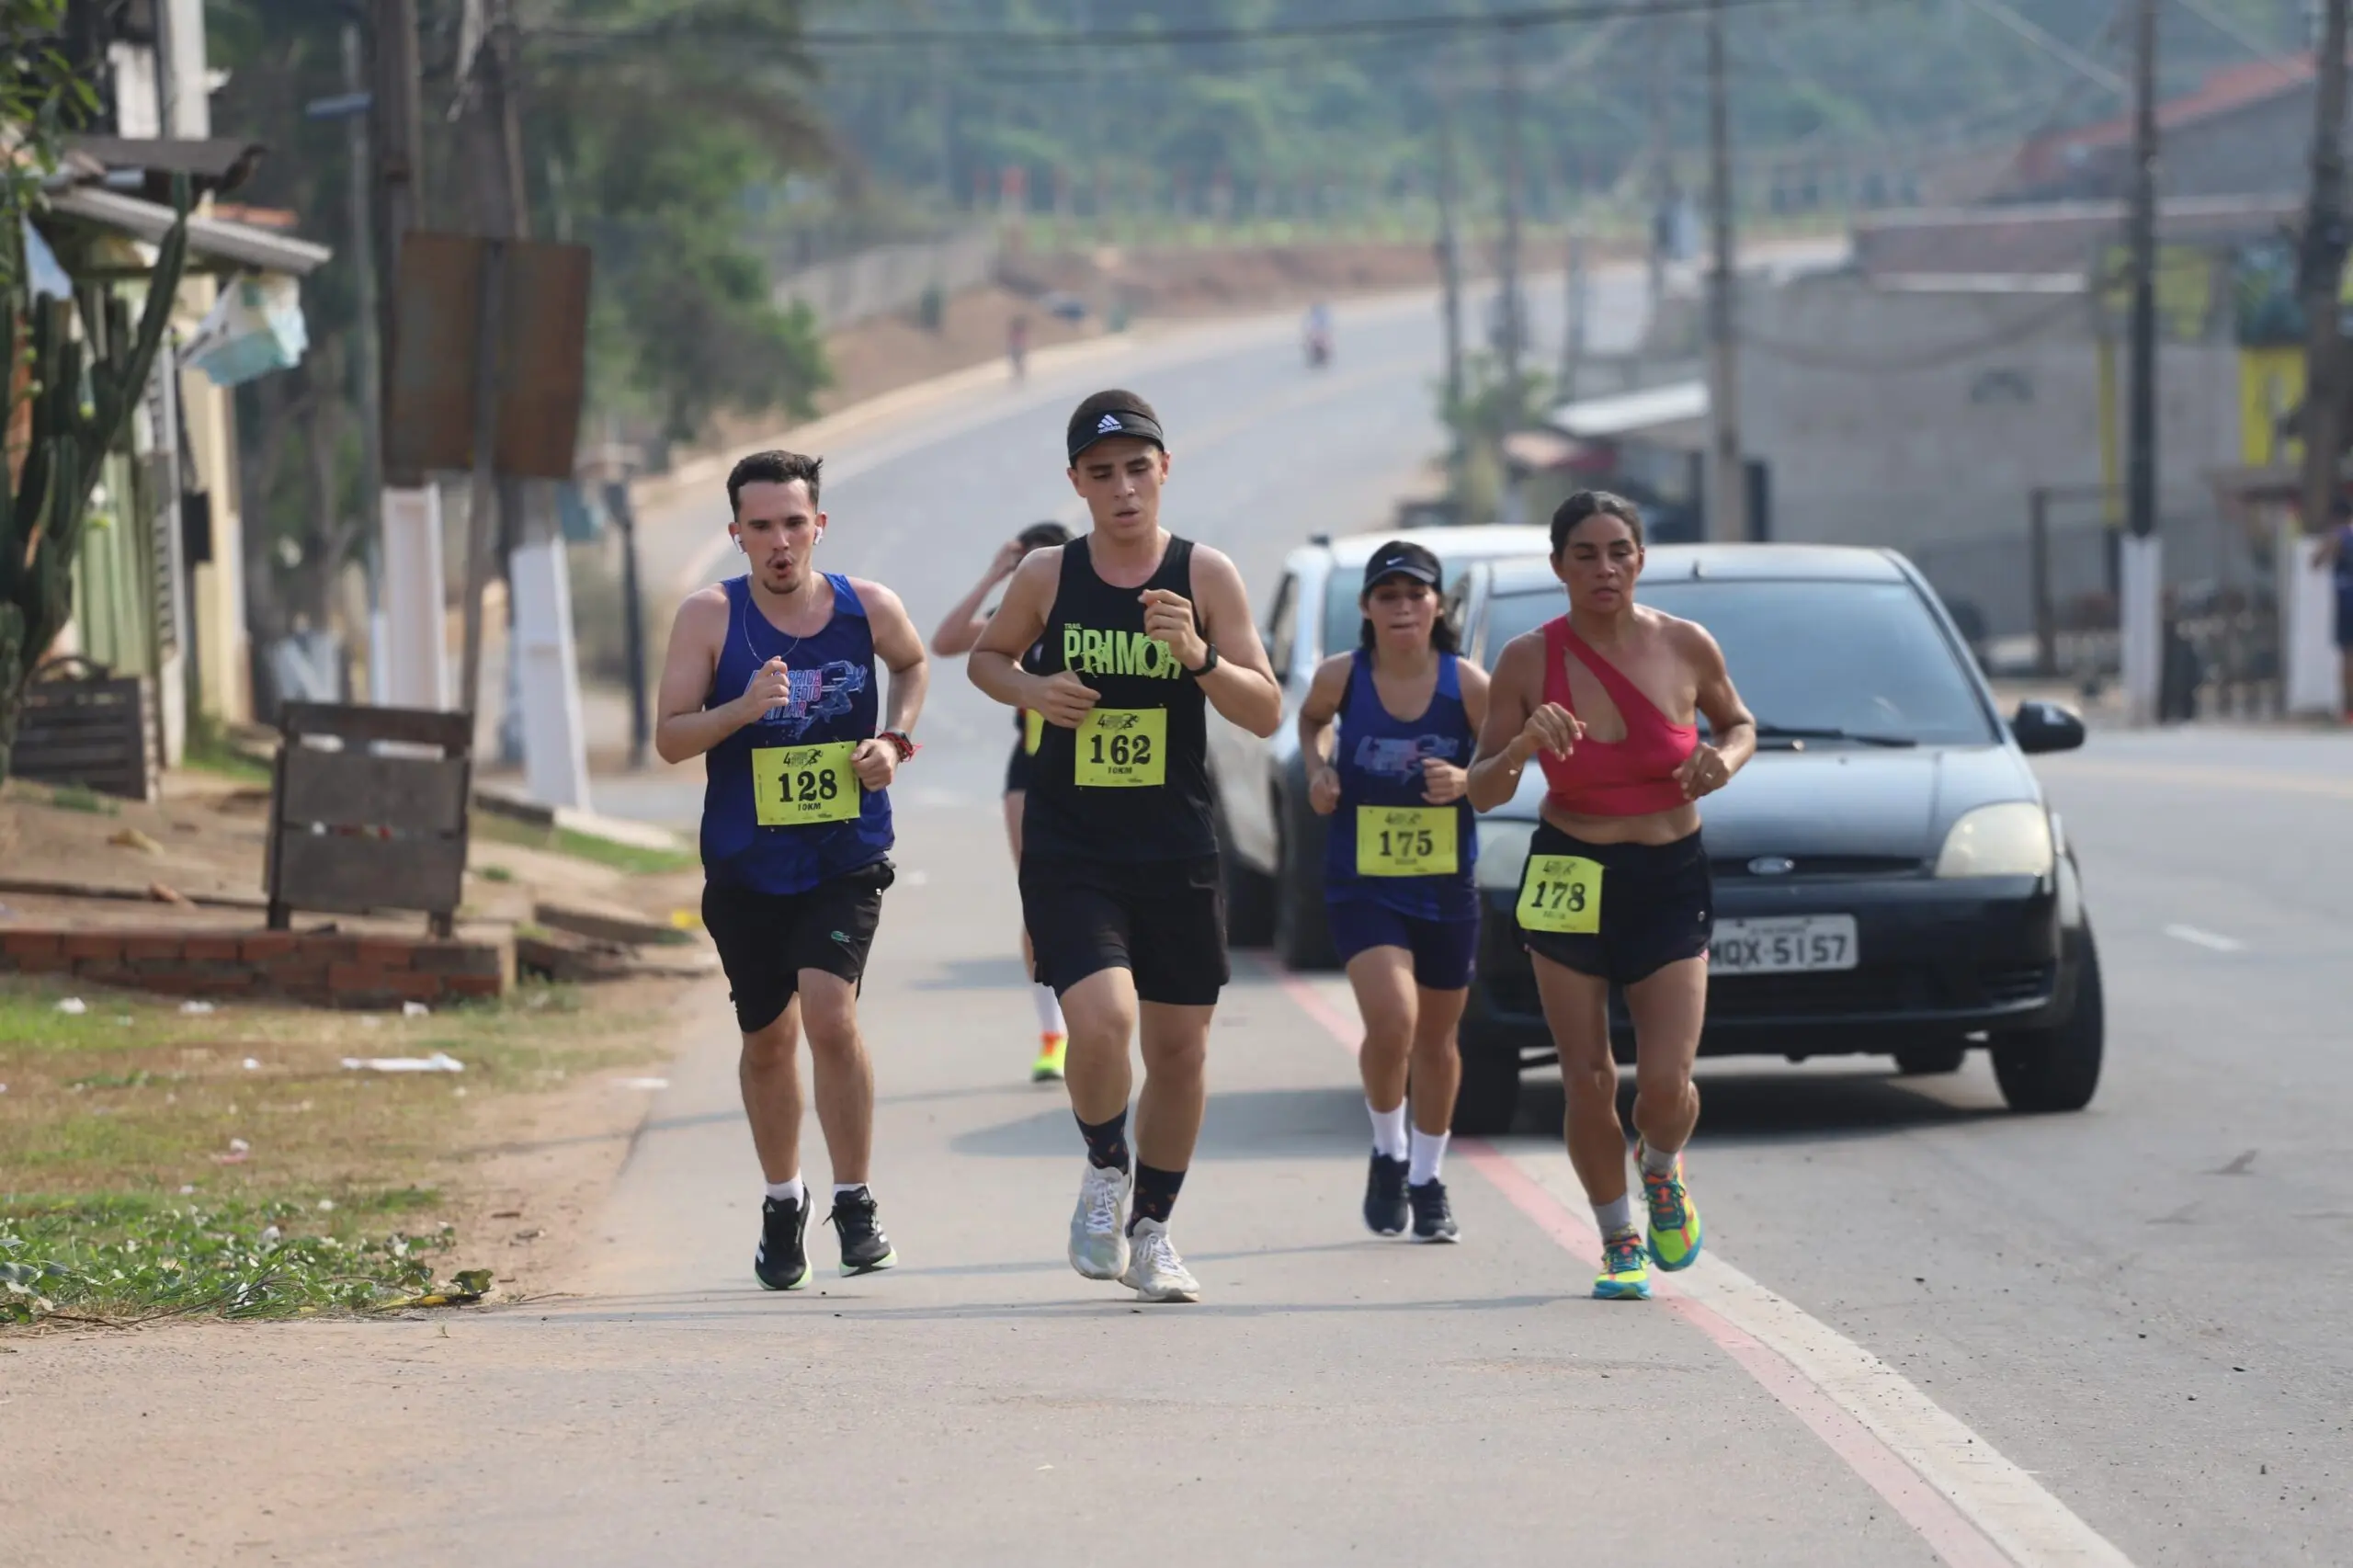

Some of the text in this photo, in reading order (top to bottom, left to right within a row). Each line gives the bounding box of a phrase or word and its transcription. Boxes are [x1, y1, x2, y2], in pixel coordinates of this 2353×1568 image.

[1097, 424, 1122, 434] adidas
[1089, 733, 1151, 765] 162
[778, 768, 838, 802] 128
[797, 801, 822, 811] 10KM
[1379, 829, 1433, 857] 175
[1530, 880, 1586, 912] 178
